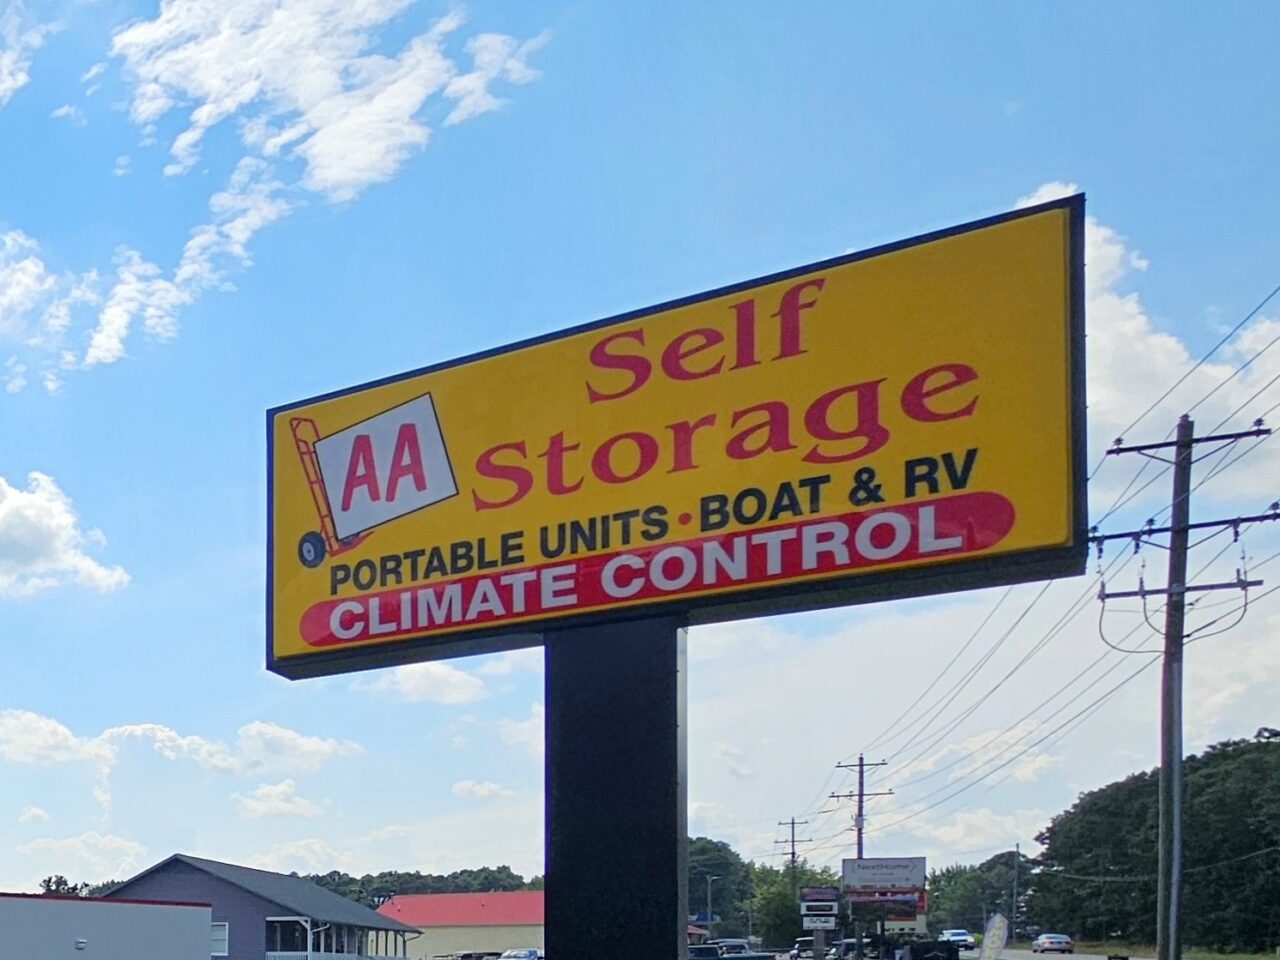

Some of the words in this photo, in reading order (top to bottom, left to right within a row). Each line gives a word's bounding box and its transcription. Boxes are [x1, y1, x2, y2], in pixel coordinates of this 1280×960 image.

[586, 277, 827, 405] Self
[341, 423, 427, 512] AA
[471, 362, 980, 512] Storage
[329, 563, 579, 640] CLIMATE
[600, 505, 963, 599] CONTROL
[330, 530, 525, 596] PORTABLE
[539, 505, 669, 559] UNITS
[700, 474, 831, 532] BOAT
[848, 466, 886, 507] &
[904, 448, 979, 498] RV
